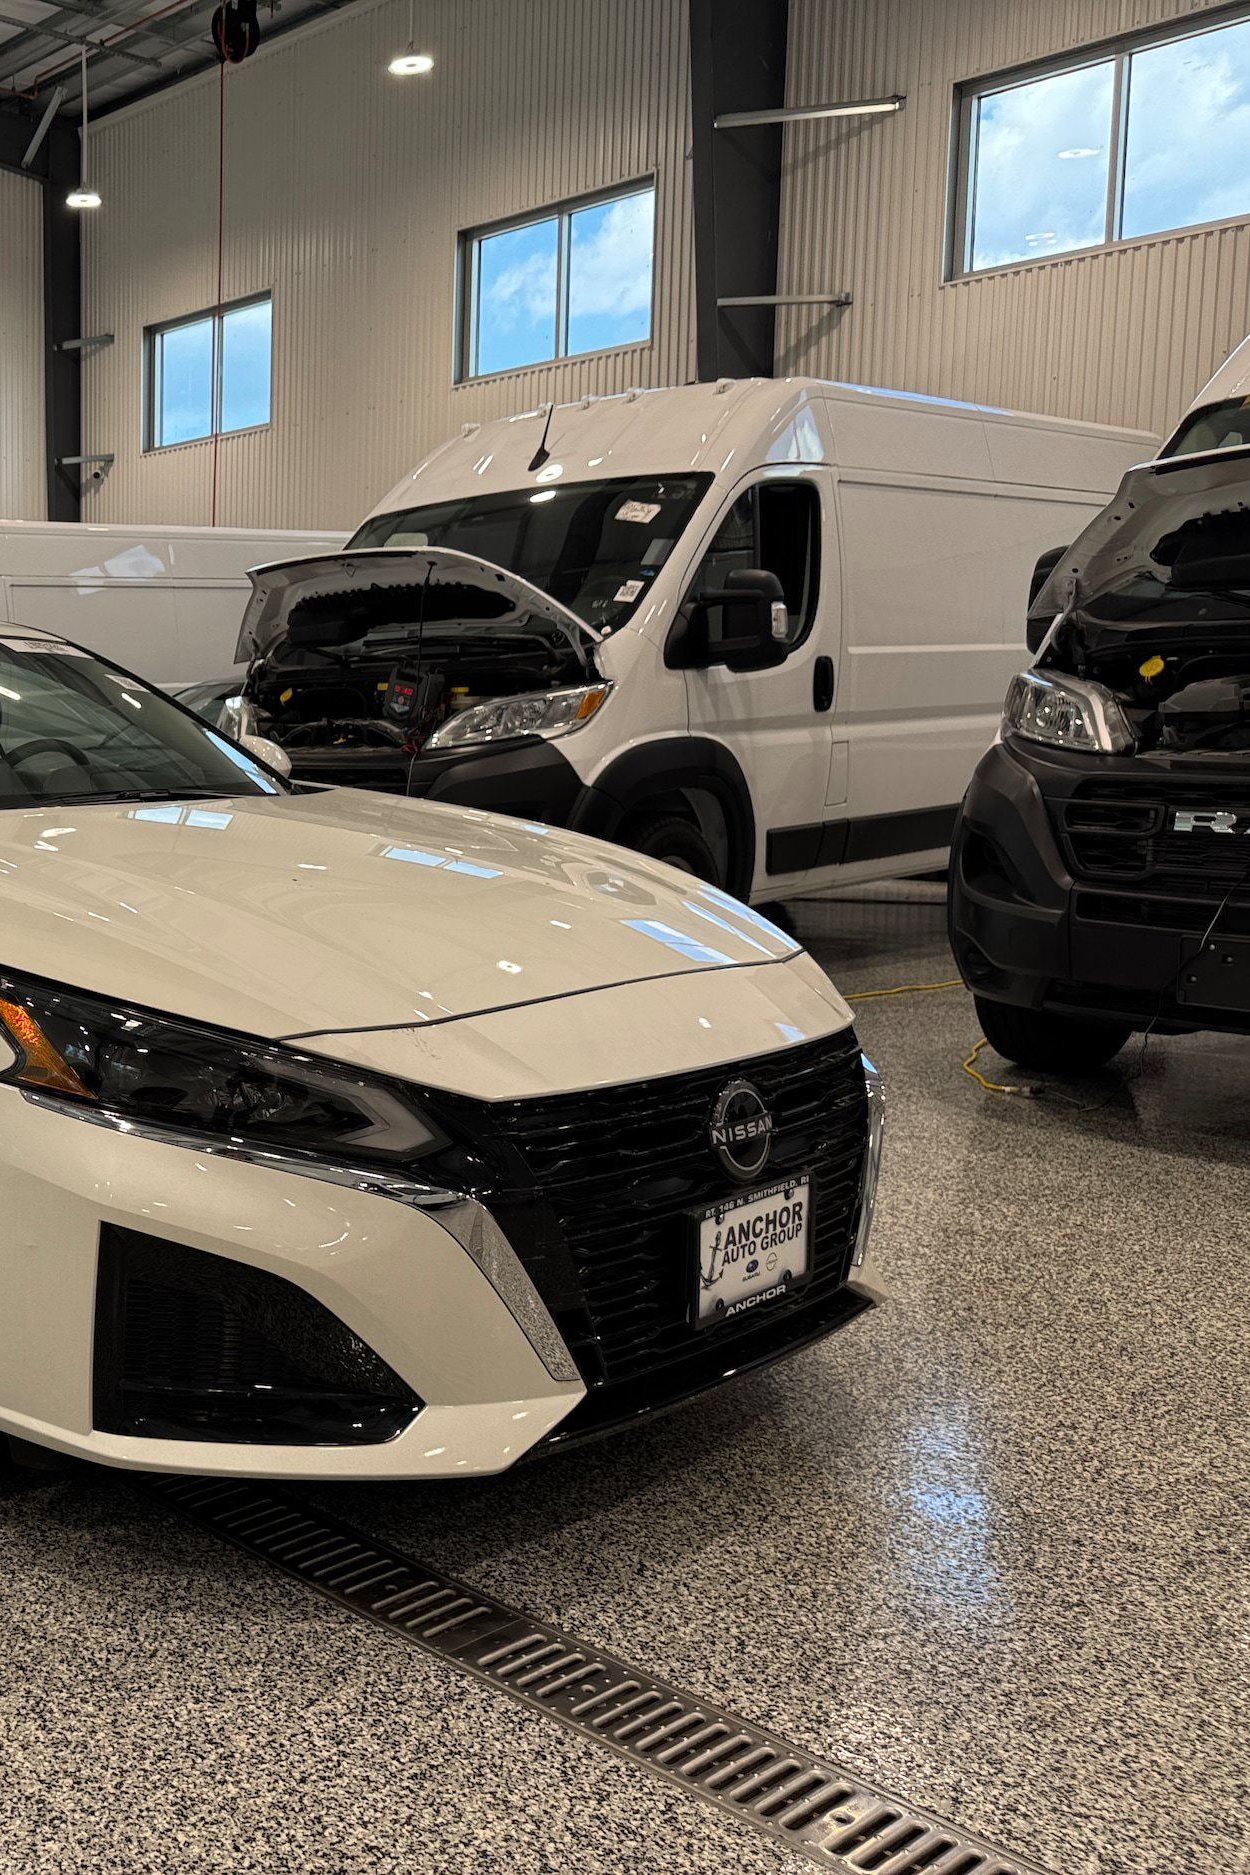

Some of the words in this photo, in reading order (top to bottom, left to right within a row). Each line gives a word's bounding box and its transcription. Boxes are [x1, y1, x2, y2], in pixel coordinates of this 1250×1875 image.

[1173, 811, 1250, 835] R
[711, 1115, 773, 1145] NISSAN
[719, 1200, 735, 1214] 146
[800, 1174, 810, 1185] RI
[724, 1201, 803, 1250] ANCHOR
[721, 1241, 757, 1267] AUTO
[760, 1222, 803, 1251] GROUP
[725, 1284, 787, 1318] ANCHOR
